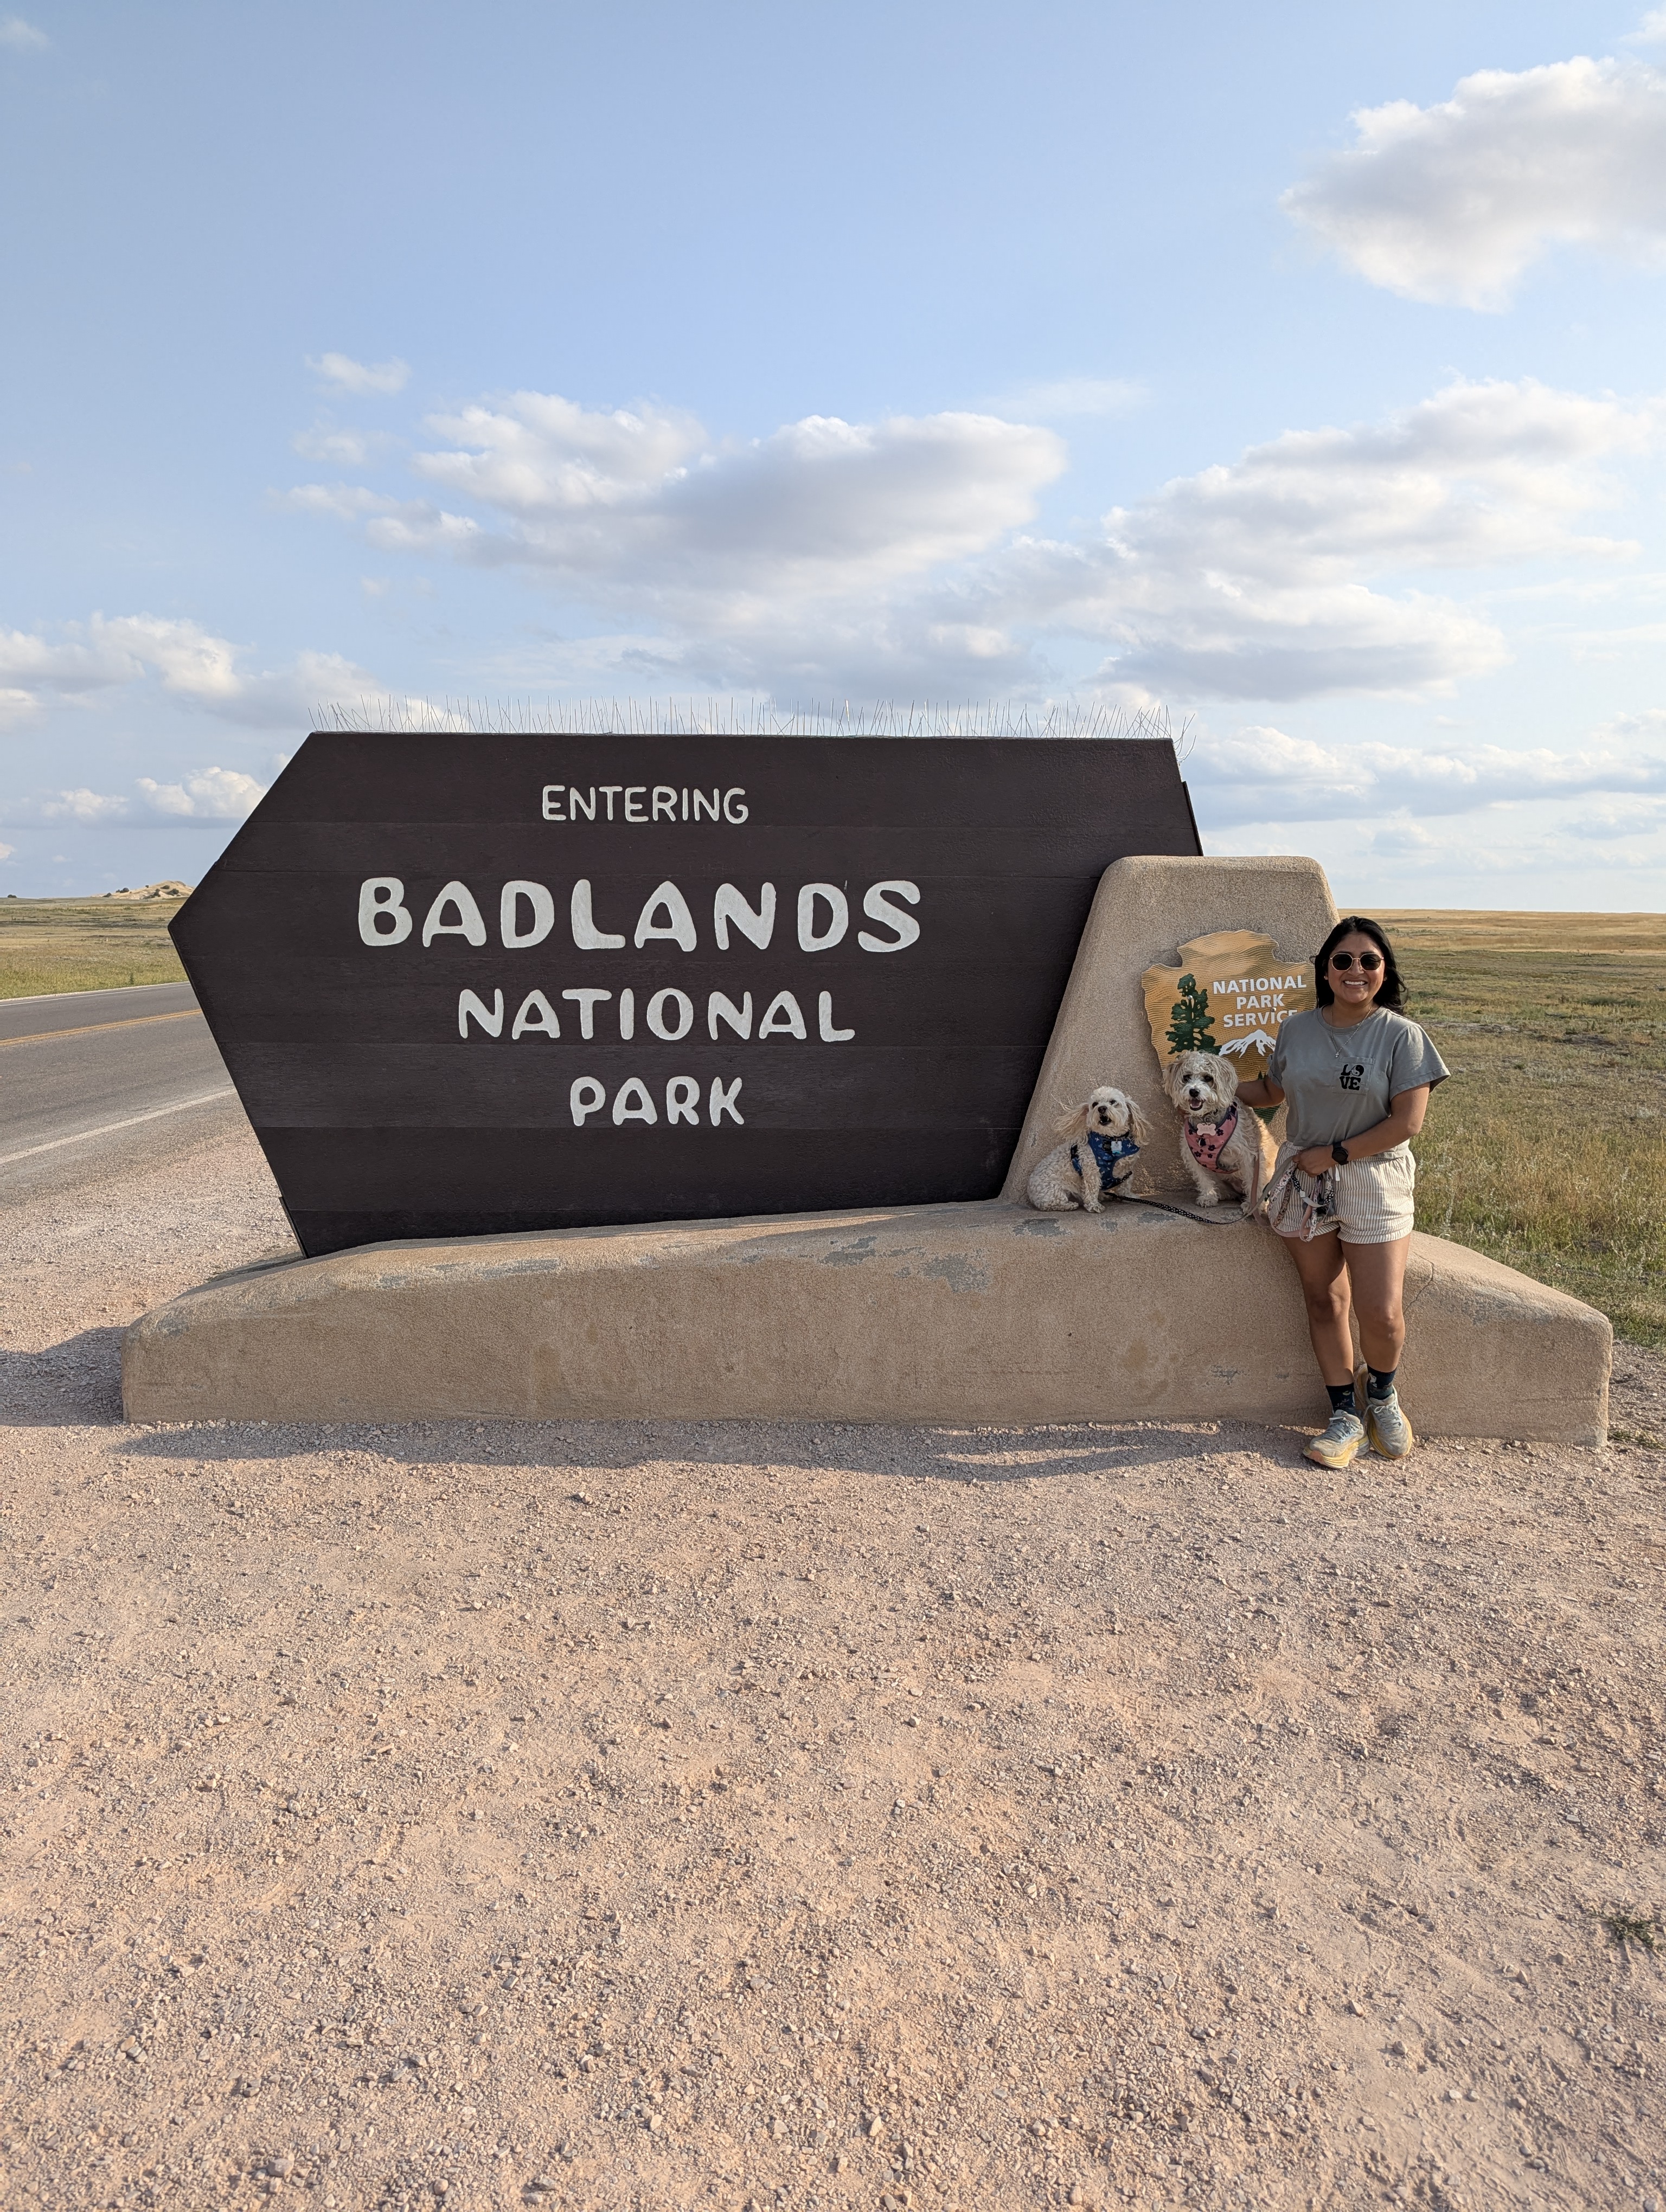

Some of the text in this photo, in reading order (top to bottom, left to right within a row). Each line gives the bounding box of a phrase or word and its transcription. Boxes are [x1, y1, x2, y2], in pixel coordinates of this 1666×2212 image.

[541, 785, 749, 825] ENTERING
[357, 876, 921, 953] BADLANDS
[1213, 974, 1307, 994] NATIONAL
[1236, 993, 1285, 1009] PARK
[458, 987, 856, 1043] NATIONAL
[569, 1075, 745, 1127] PARK
